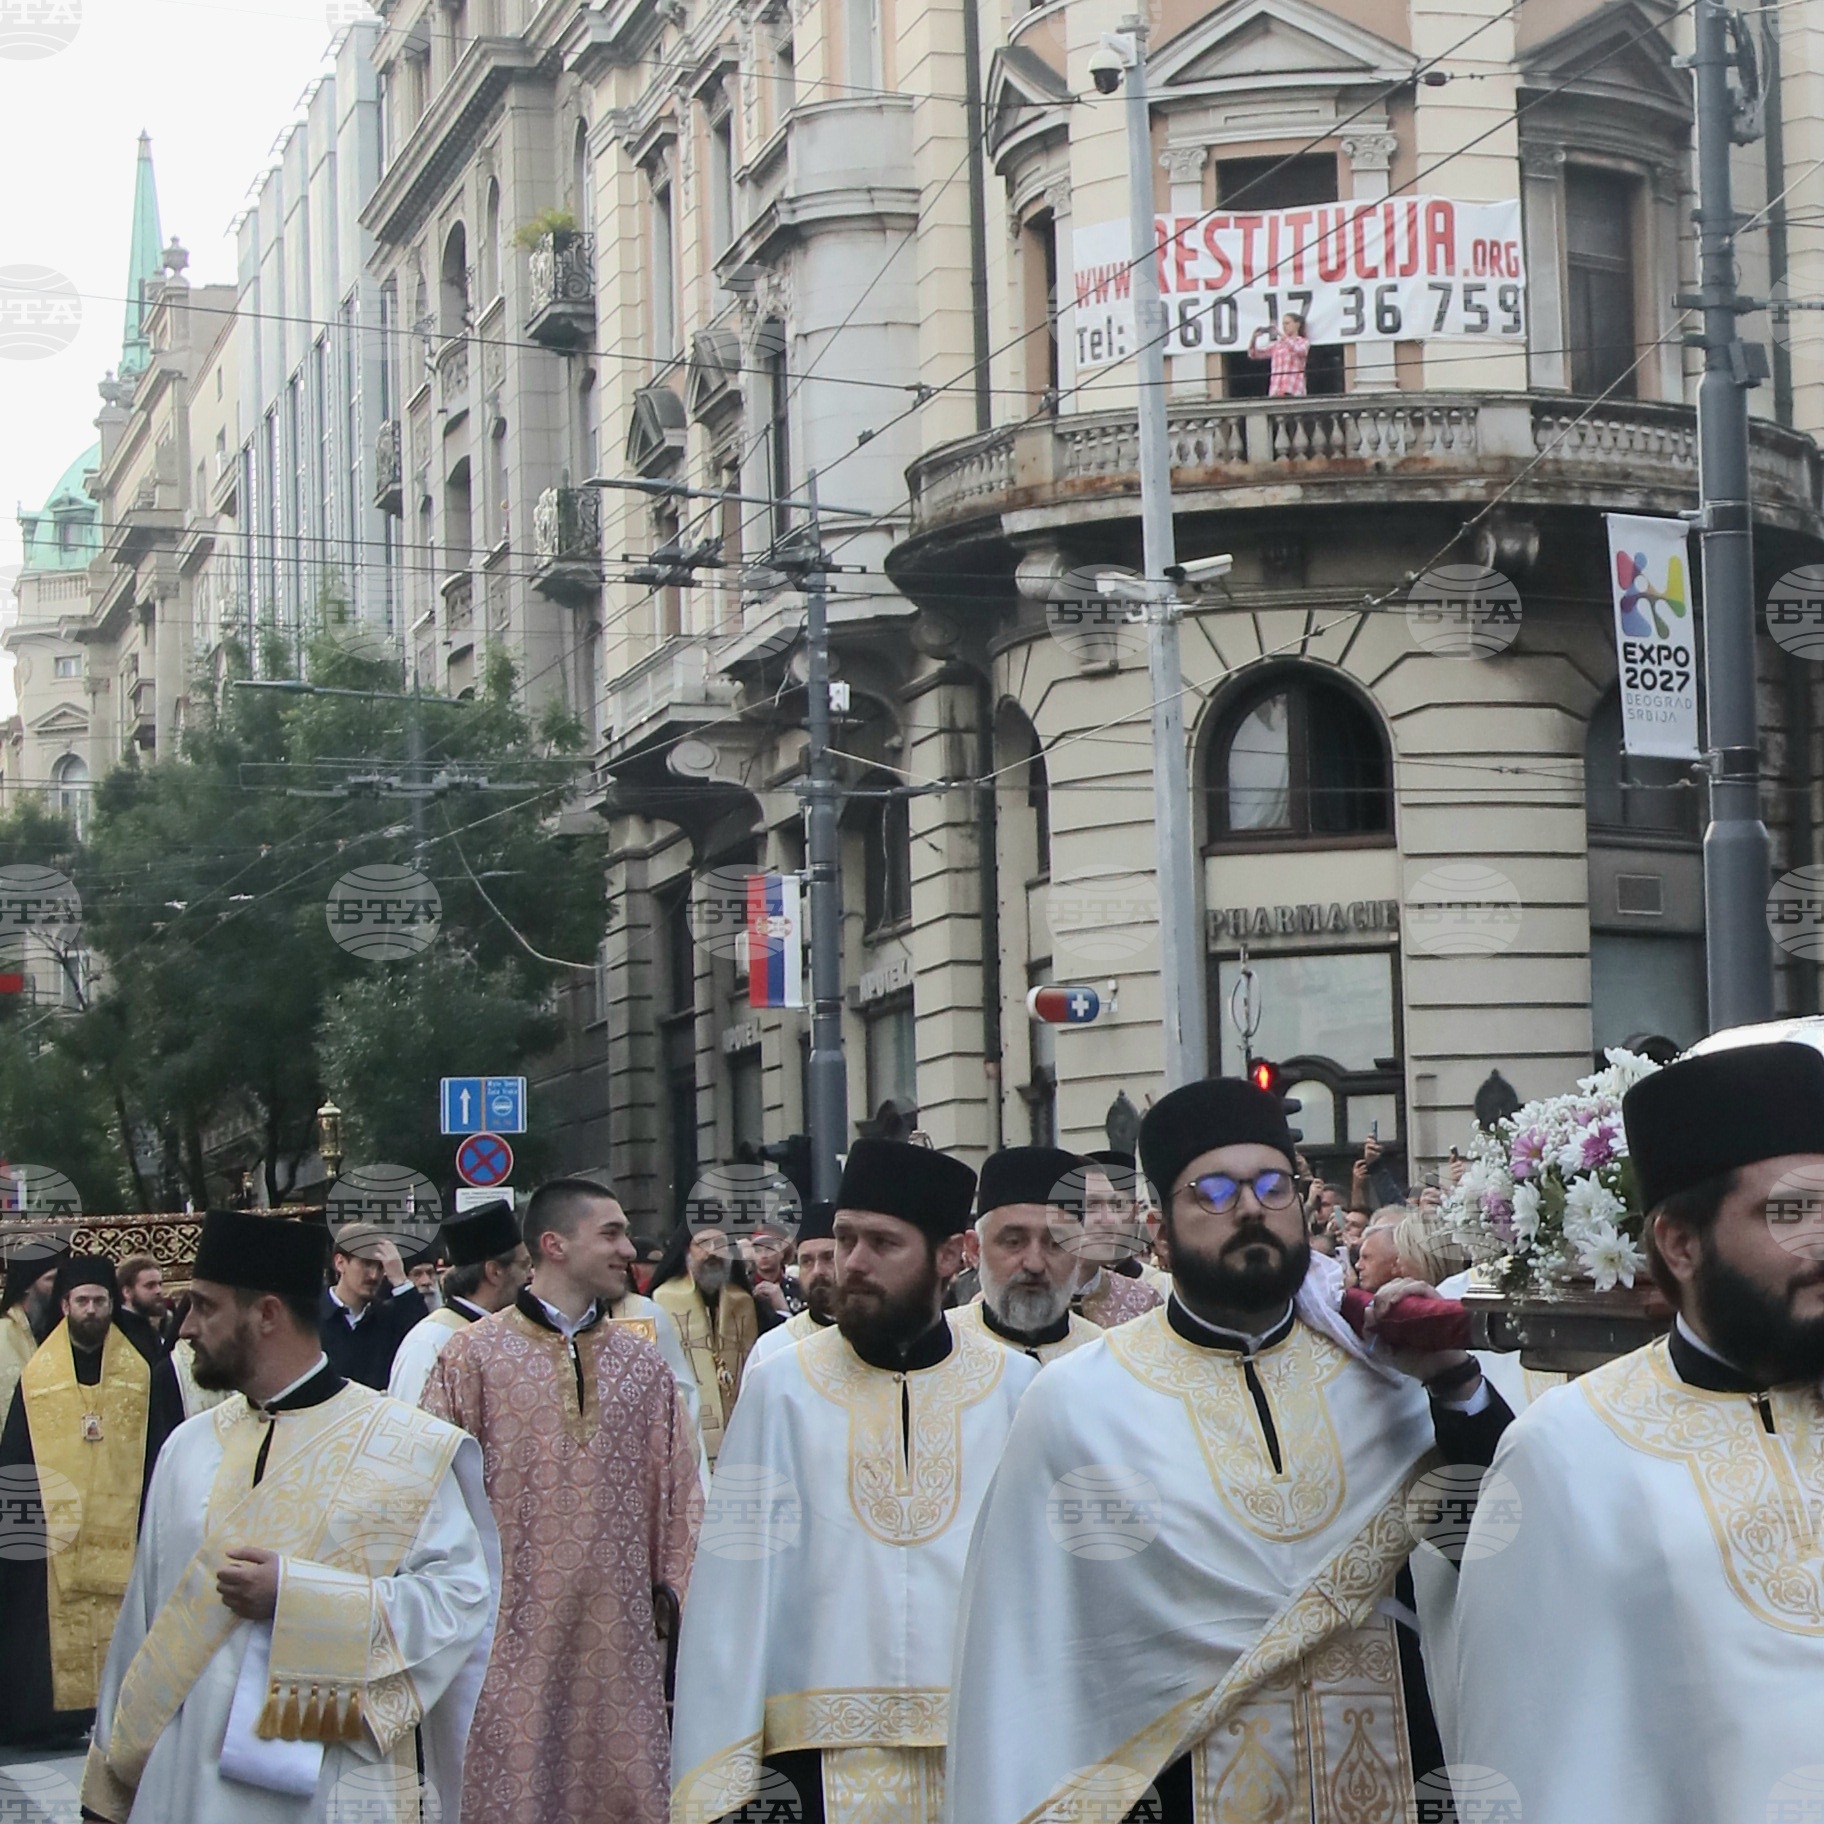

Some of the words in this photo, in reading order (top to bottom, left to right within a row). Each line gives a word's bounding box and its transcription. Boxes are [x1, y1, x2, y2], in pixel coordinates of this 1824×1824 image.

[1338, 282, 1402, 337] 36
[1427, 281, 1522, 335] 759
[1622, 641, 1690, 668] EXPO
[1624, 667, 1691, 693] 2027
[1626, 692, 1693, 711] BEOGRAD
[1627, 706, 1678, 724] SRBIJA
[1206, 898, 1400, 938] PHARMACIE
